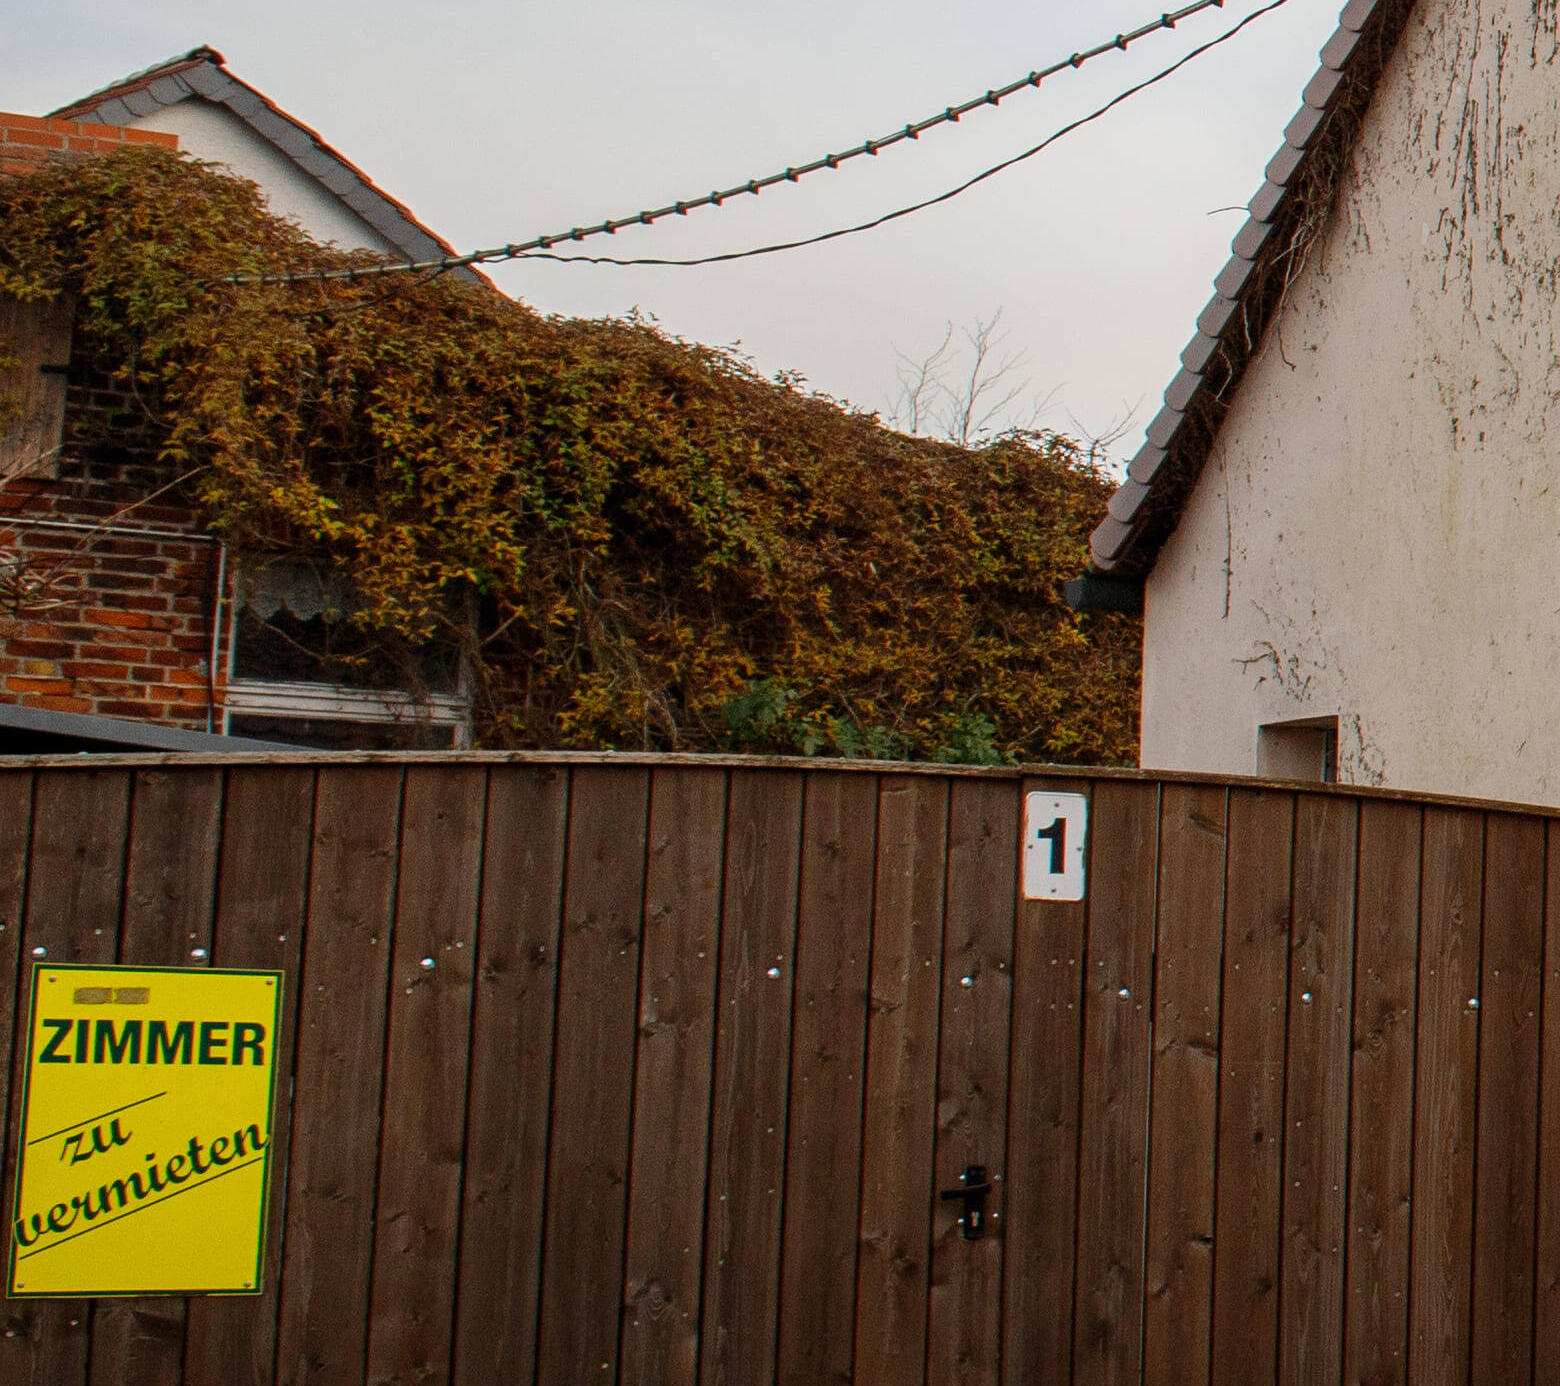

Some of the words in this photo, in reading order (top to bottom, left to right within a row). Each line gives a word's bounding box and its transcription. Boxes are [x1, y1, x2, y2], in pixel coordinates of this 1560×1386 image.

[1037, 817, 1067, 874] 1
[38, 1018, 266, 1066] ZIMMER
[59, 1118, 133, 1166] zu
[14, 1123, 270, 1247] vermieten
